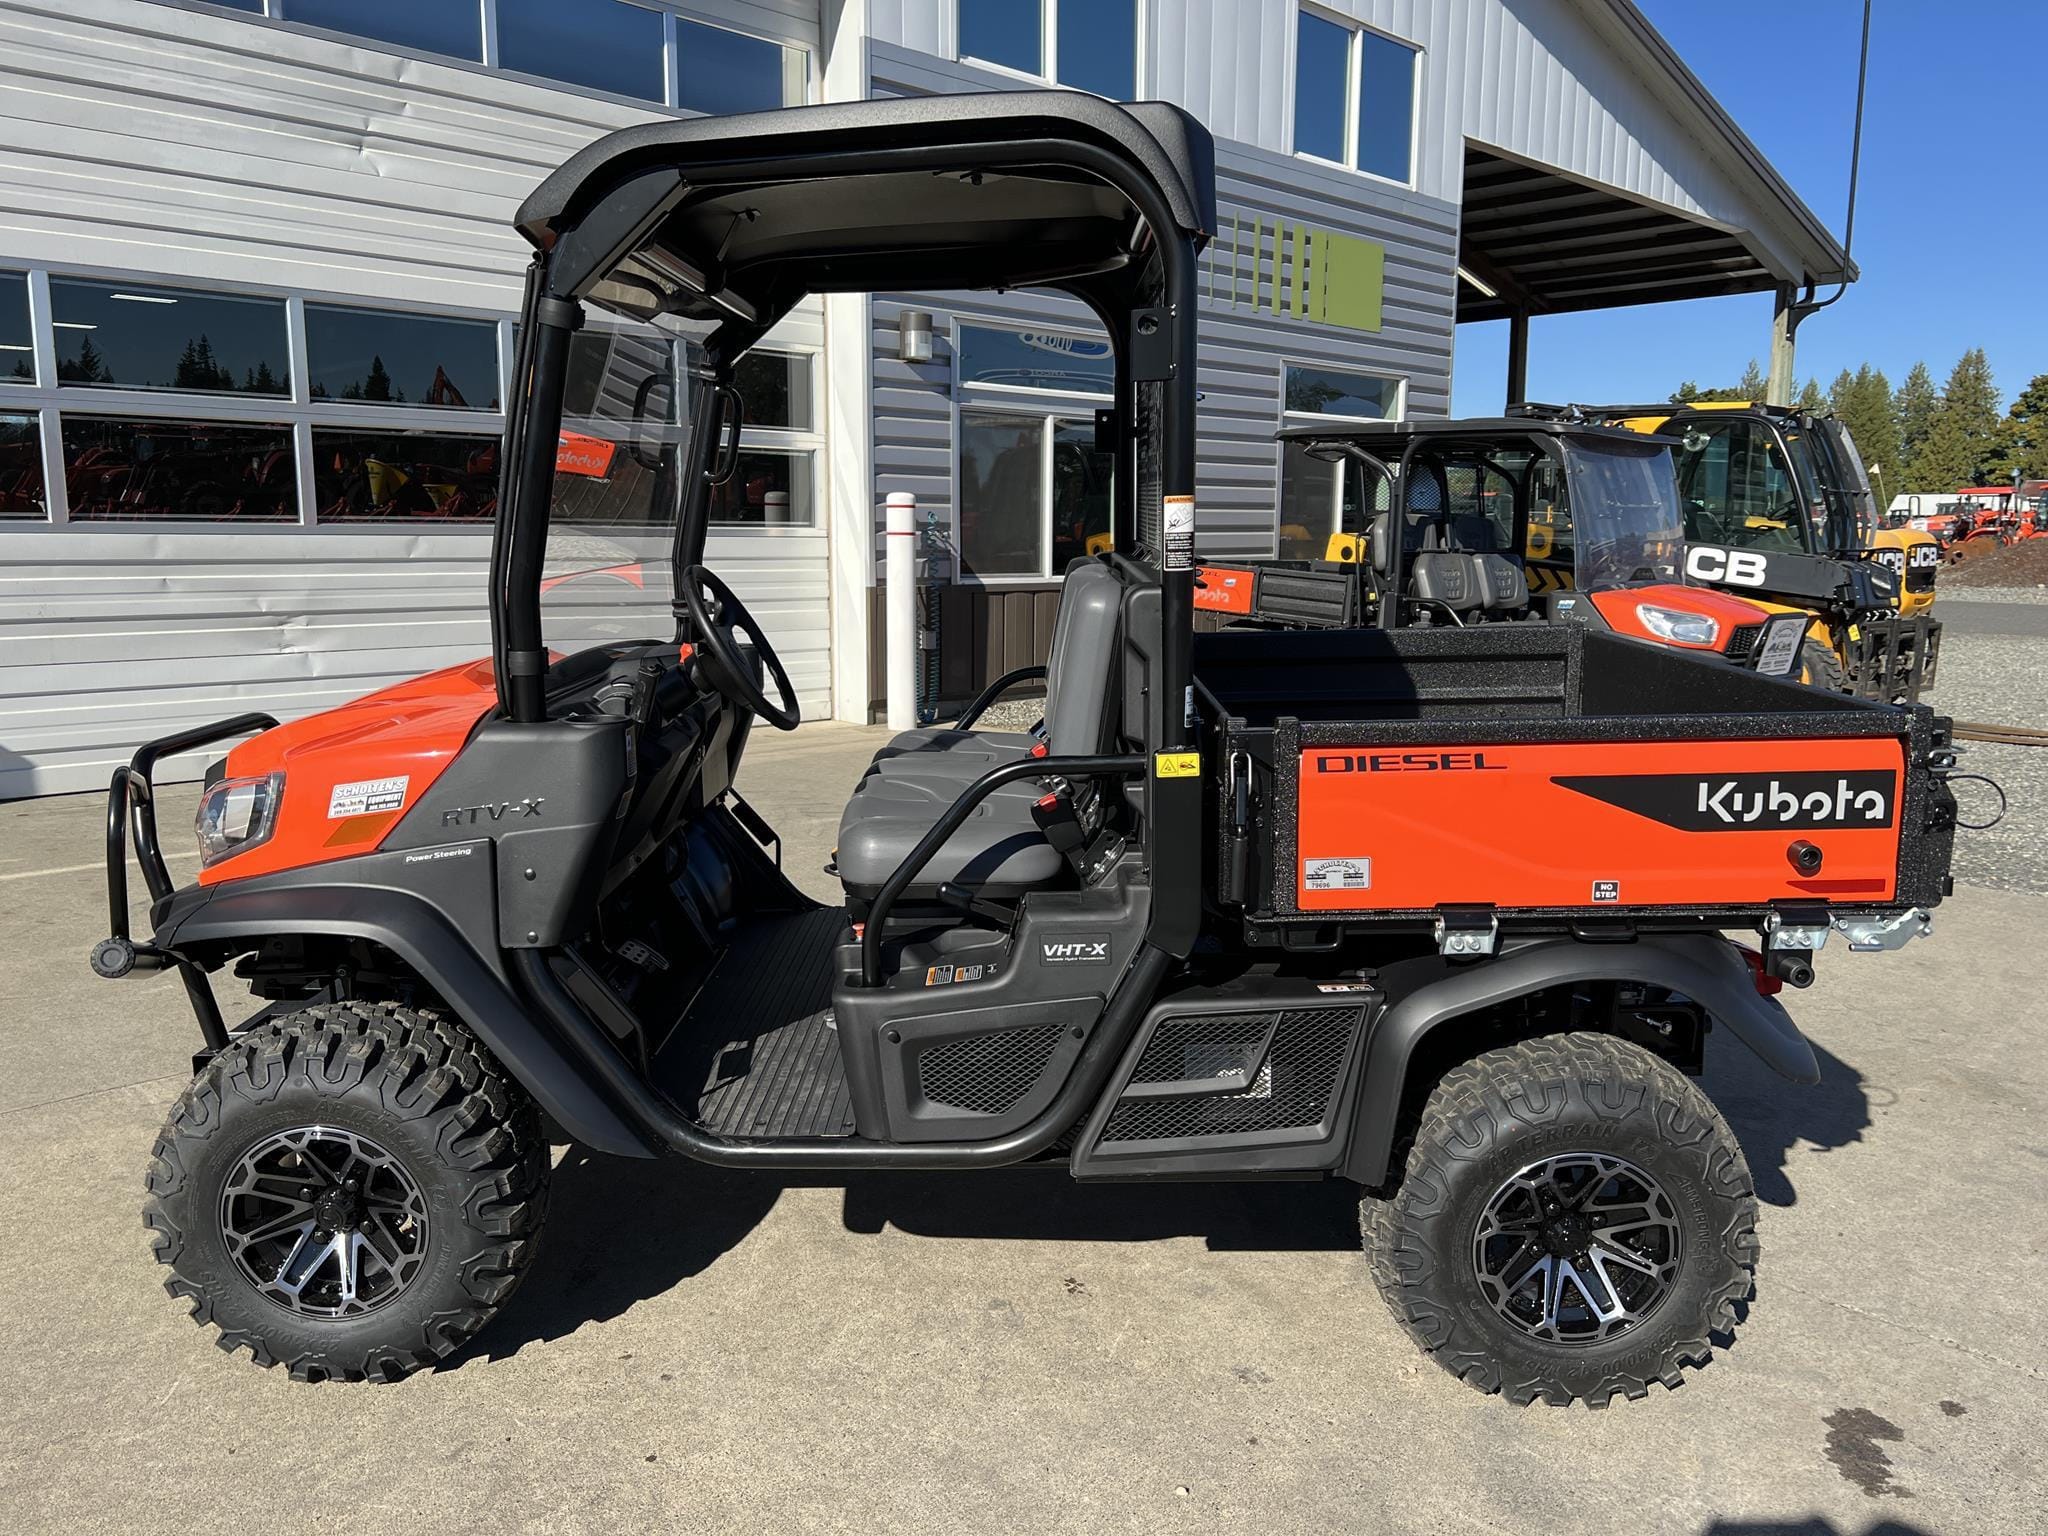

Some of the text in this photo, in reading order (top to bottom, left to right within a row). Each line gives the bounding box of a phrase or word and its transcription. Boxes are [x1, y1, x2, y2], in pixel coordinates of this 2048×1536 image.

[1683, 545, 1767, 587] CB
[1910, 547, 1937, 567] JCB
[1316, 752, 1507, 774] DIESEL
[335, 779, 406, 799] SCHOLTEN'S
[1697, 779, 1885, 822] Kubota
[441, 798, 545, 827] RTV-X
[405, 847, 472, 863] Power Steering
[1600, 883, 1614, 891] NO
[1043, 943, 1108, 956] VHT-X
[1514, 1122, 1620, 1152] TERRAIN
